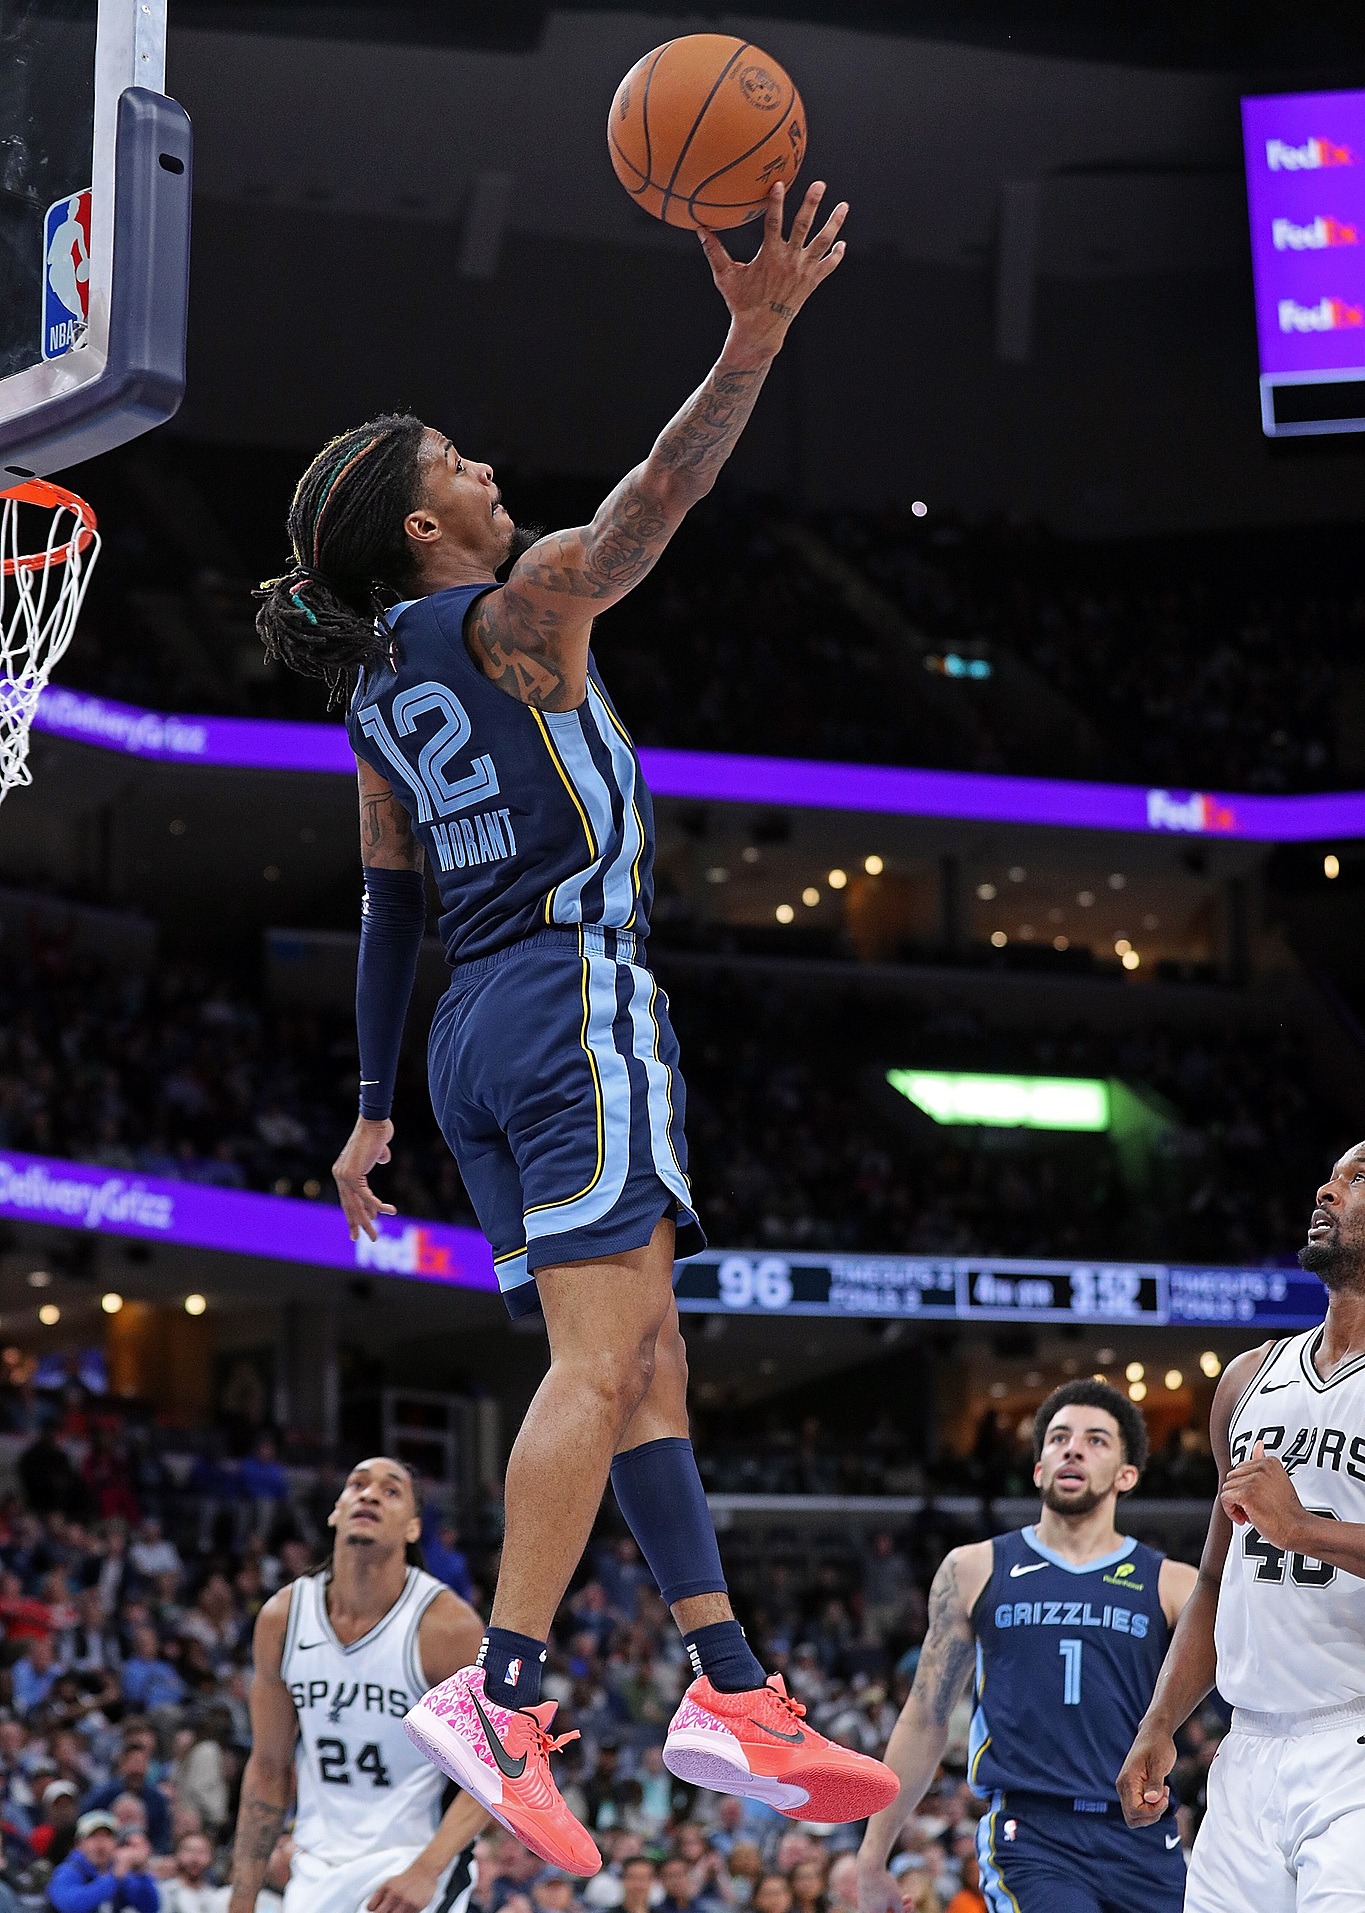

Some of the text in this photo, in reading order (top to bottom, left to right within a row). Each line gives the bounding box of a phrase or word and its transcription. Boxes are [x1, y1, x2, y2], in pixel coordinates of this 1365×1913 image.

[1267, 138, 1351, 171] FedEx
[1273, 216, 1357, 250] FedEx
[50, 319, 75, 351] NBA
[357, 681, 500, 823] 12
[1148, 790, 1236, 832] FedEx
[430, 807, 517, 872] MORANT
[717, 1257, 795, 1309] 96
[994, 1601, 1150, 1639] GRIZZLIES
[1059, 1638, 1083, 1705] 1
[291, 1679, 408, 1723] SPURS
[316, 1738, 391, 1786] 24
